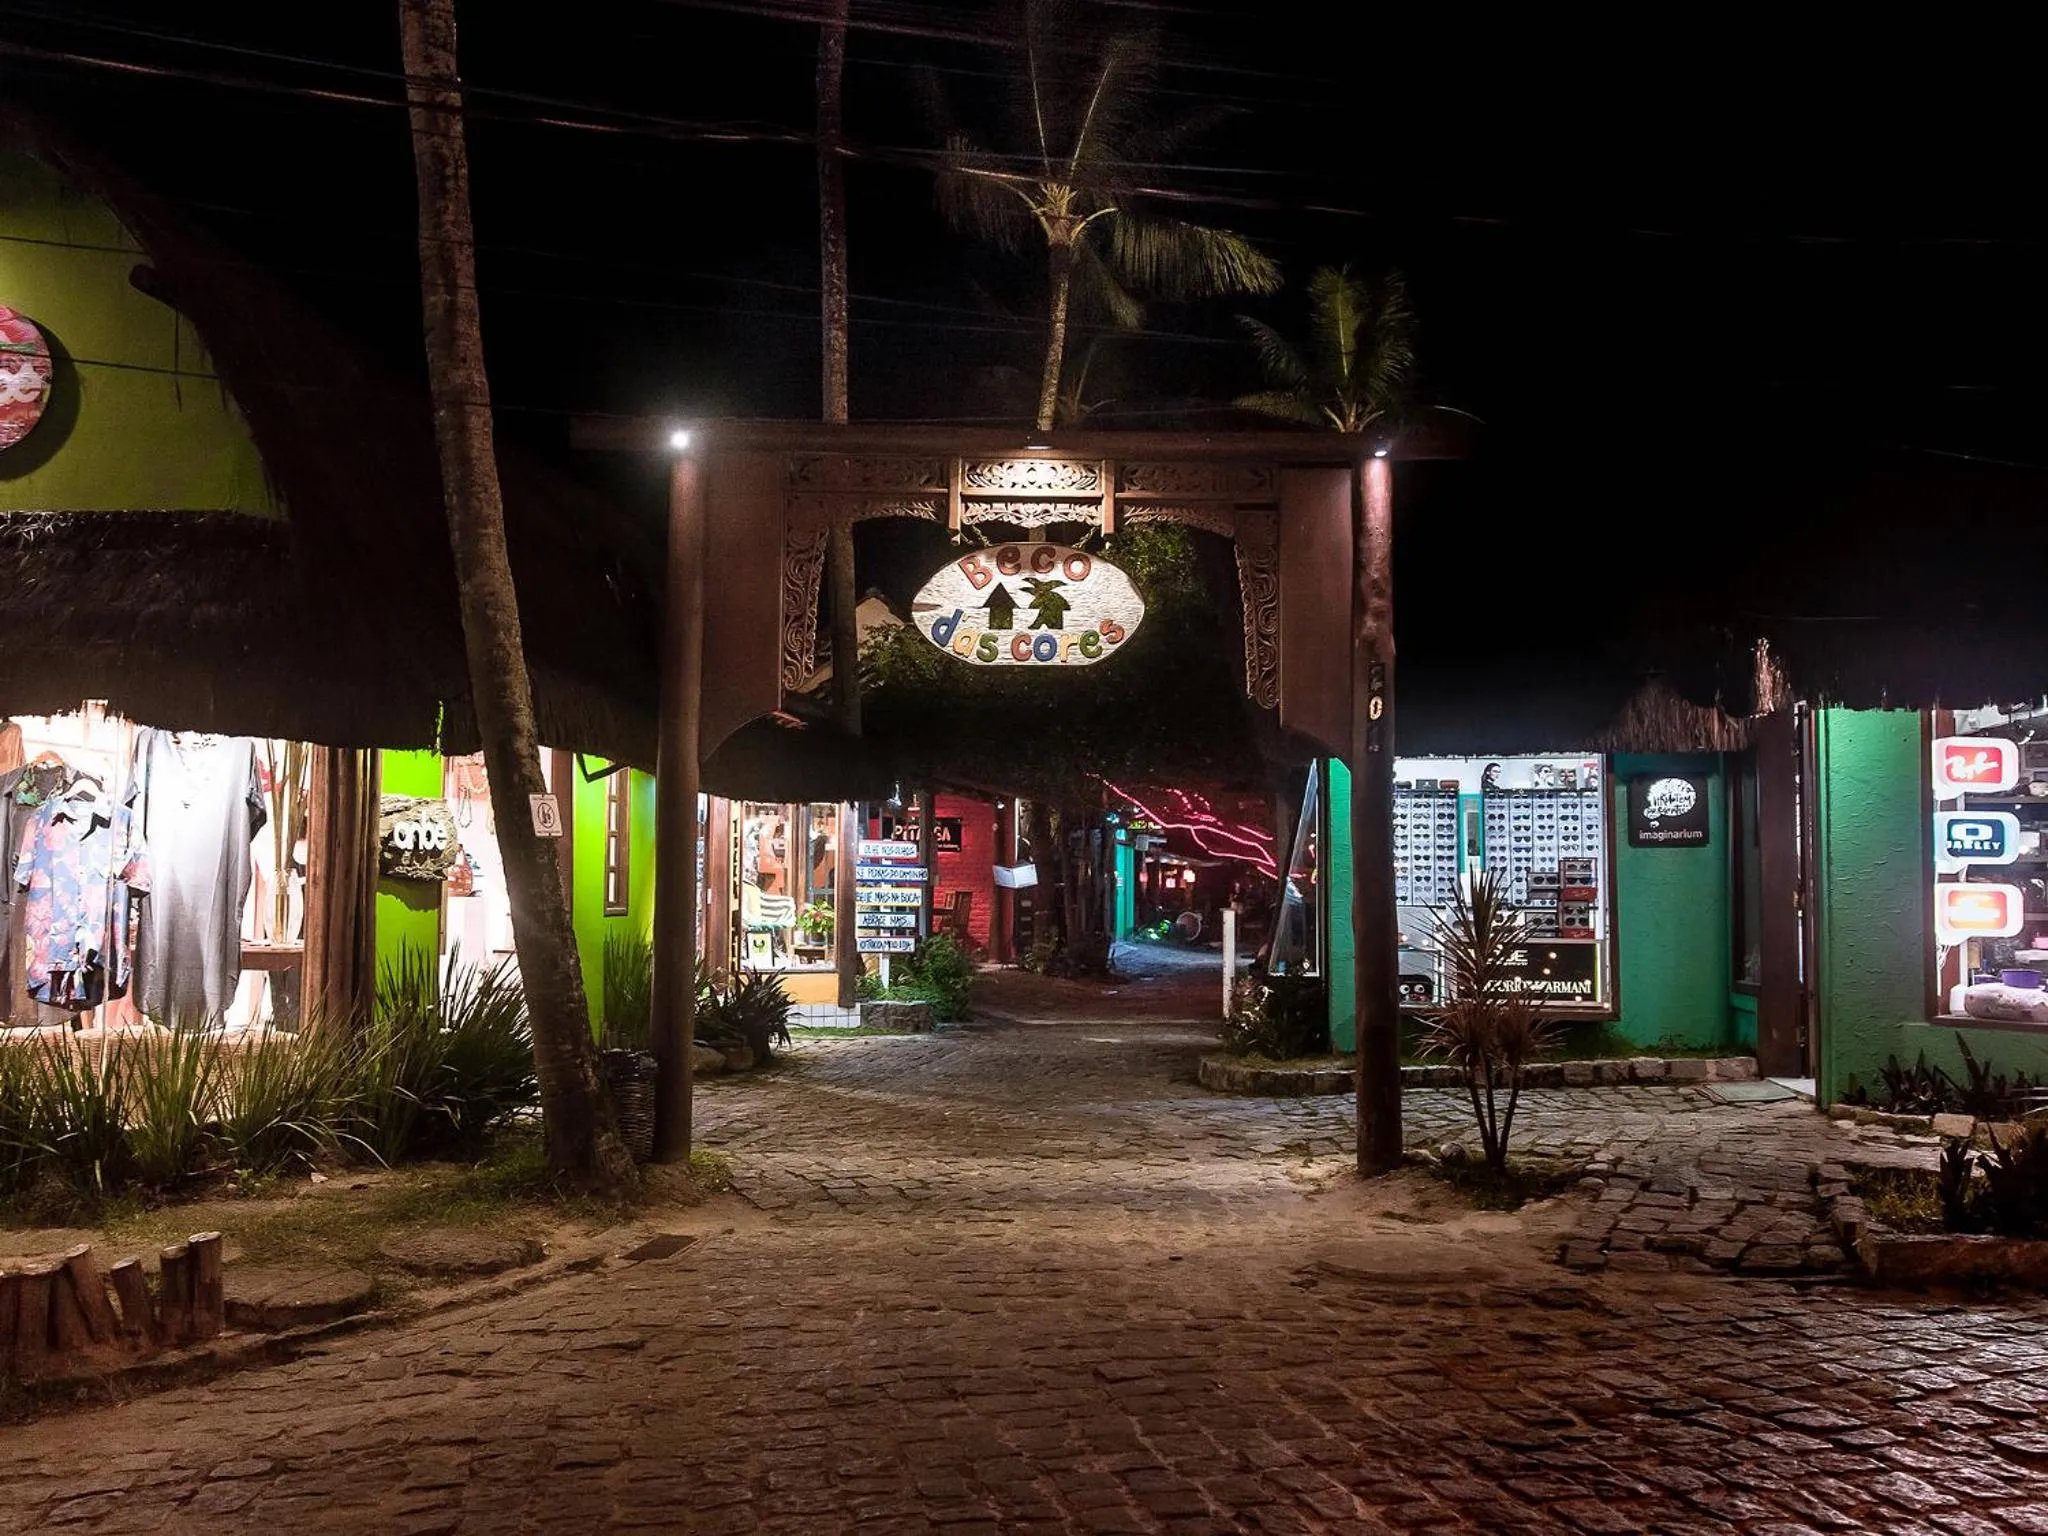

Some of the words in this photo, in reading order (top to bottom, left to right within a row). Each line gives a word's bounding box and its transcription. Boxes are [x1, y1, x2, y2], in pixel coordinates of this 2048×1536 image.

[957, 545, 1092, 590] Beco
[931, 608, 999, 662] das
[1010, 618, 1126, 662] cores
[1639, 829, 1703, 842] imaginarium
[1544, 980, 1592, 993] ARMANI
